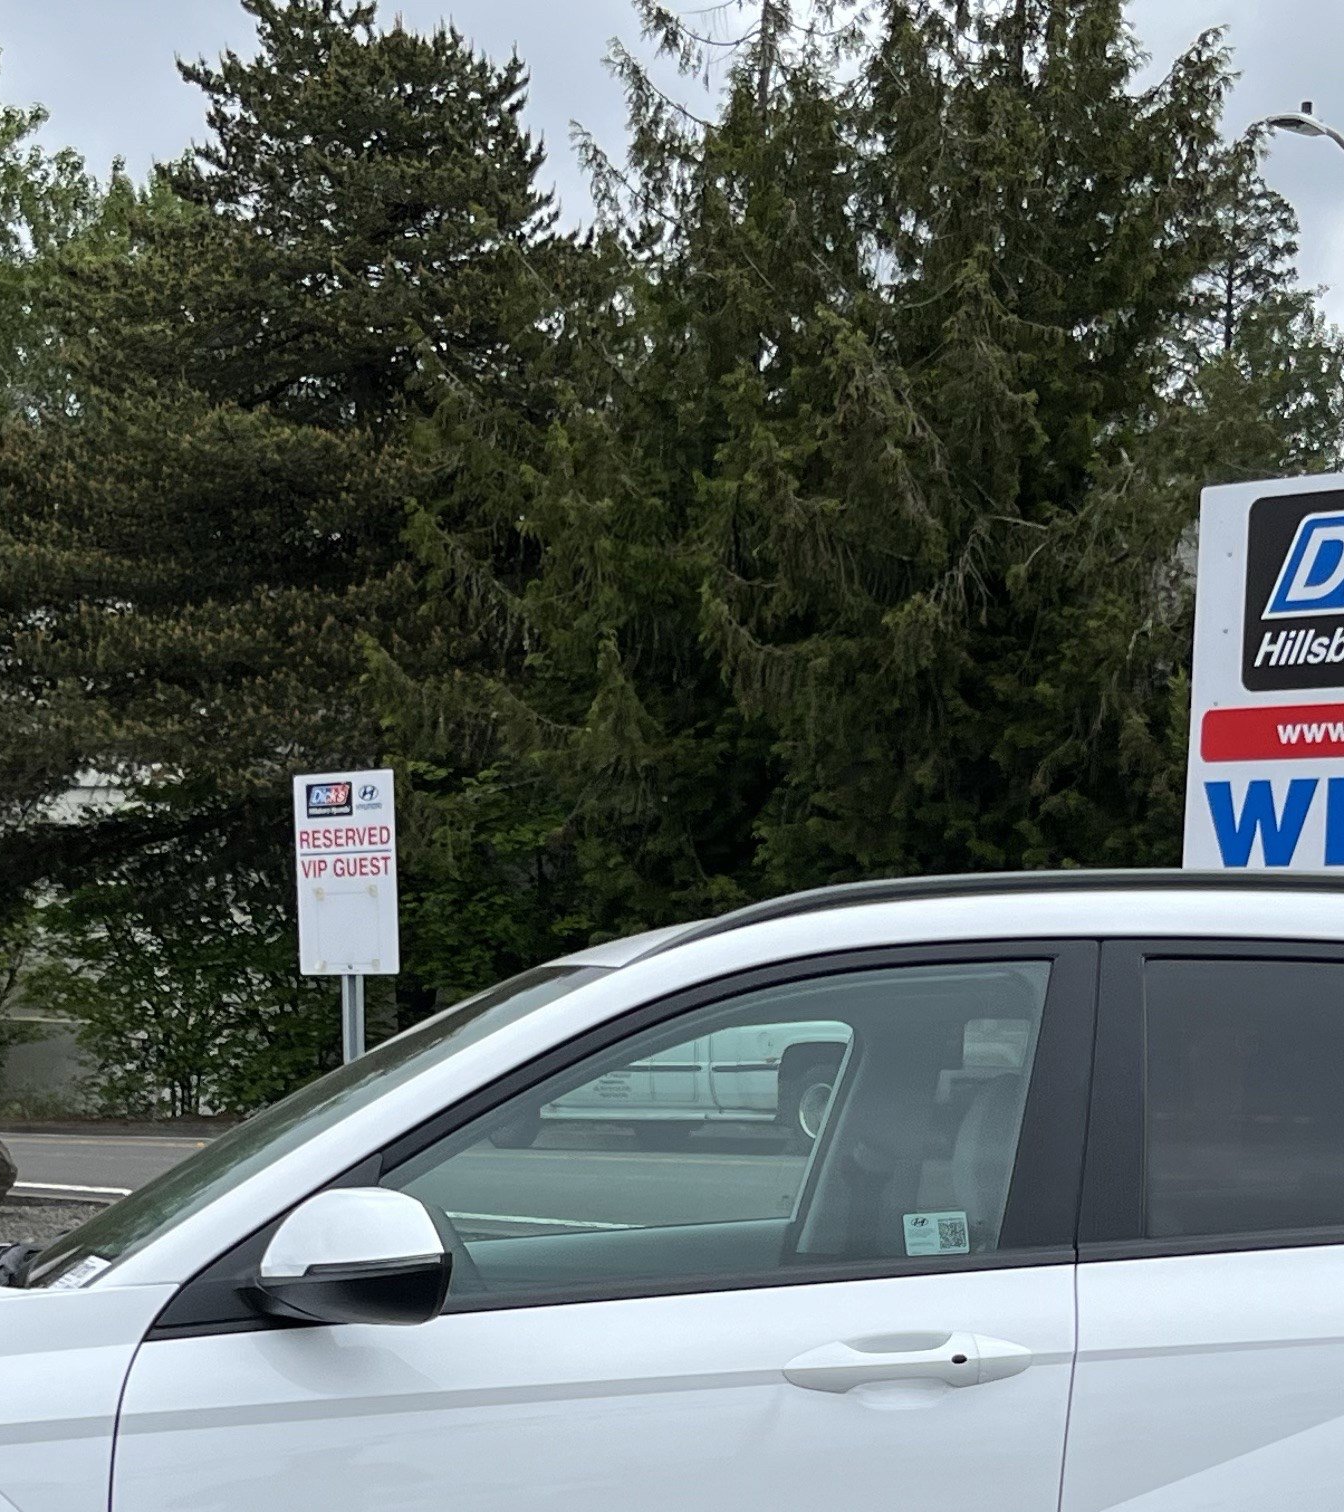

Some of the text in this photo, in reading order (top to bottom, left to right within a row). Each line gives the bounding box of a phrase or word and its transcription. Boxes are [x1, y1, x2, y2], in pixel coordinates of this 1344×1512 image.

[300, 826, 391, 849] RESERVED
[301, 857, 391, 879] VIP GUEST
